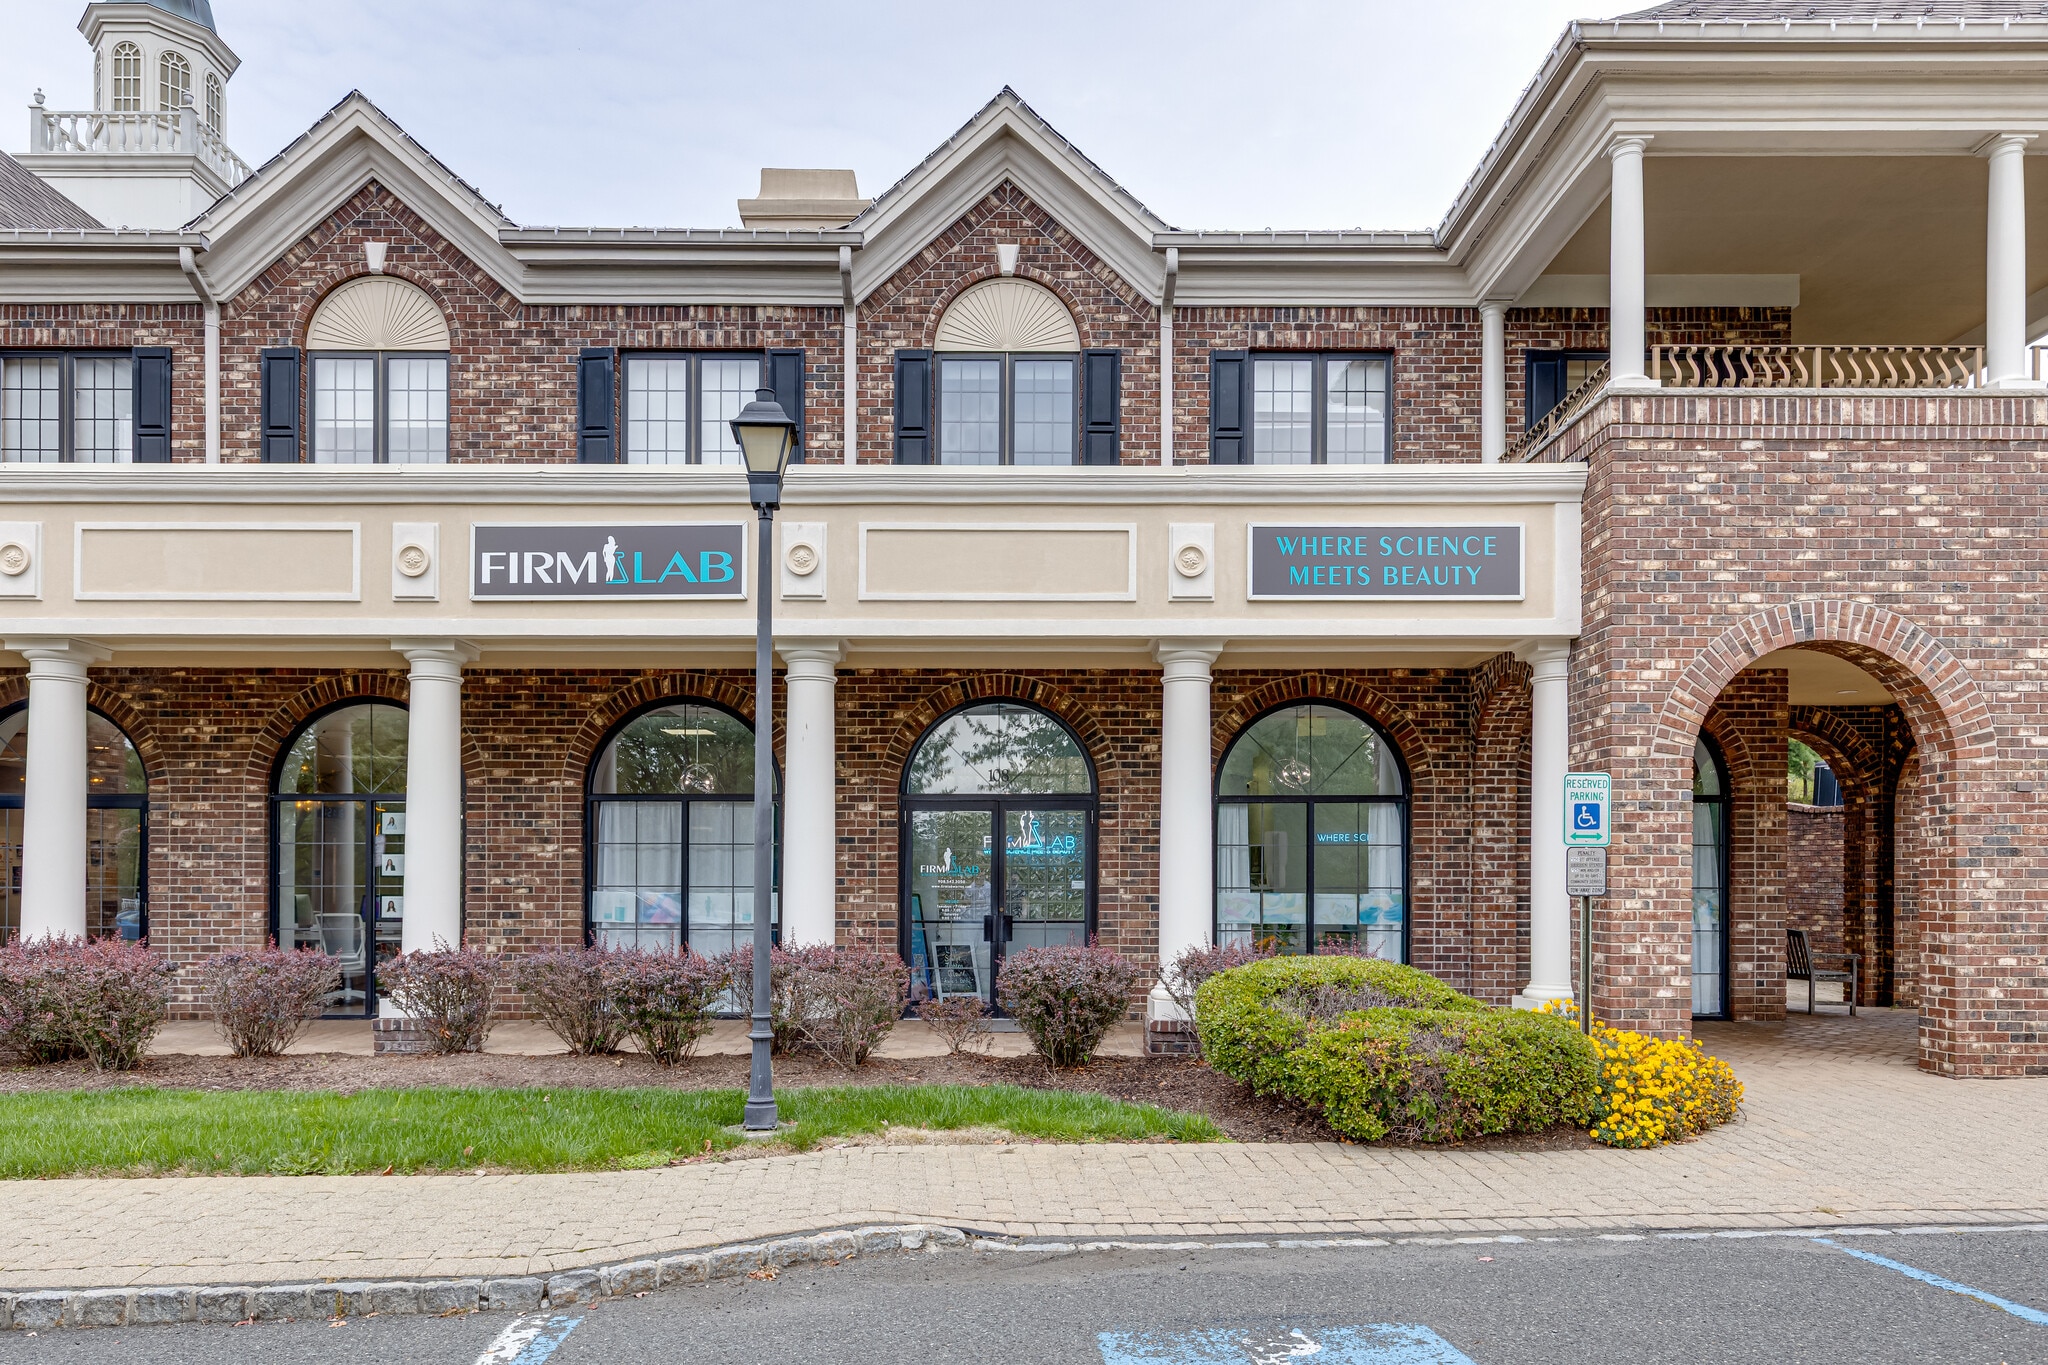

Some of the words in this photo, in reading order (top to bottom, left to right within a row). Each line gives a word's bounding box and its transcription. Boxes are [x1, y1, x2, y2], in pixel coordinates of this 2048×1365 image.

[1276, 536, 1368, 556] WHERE
[1379, 536, 1497, 556] SCIENCE
[481, 551, 597, 584] FIRM
[634, 551, 735, 584] LAB
[1289, 566, 1371, 586] MEETS
[1383, 566, 1482, 586] BEAUTY
[988, 769, 1010, 782] 108
[1566, 779, 1608, 789] RESERVED
[1570, 792, 1604, 801] PARKING
[1317, 833, 1350, 842] WHERE
[920, 865, 945, 873] FIRM
[957, 865, 980, 874] LAB
